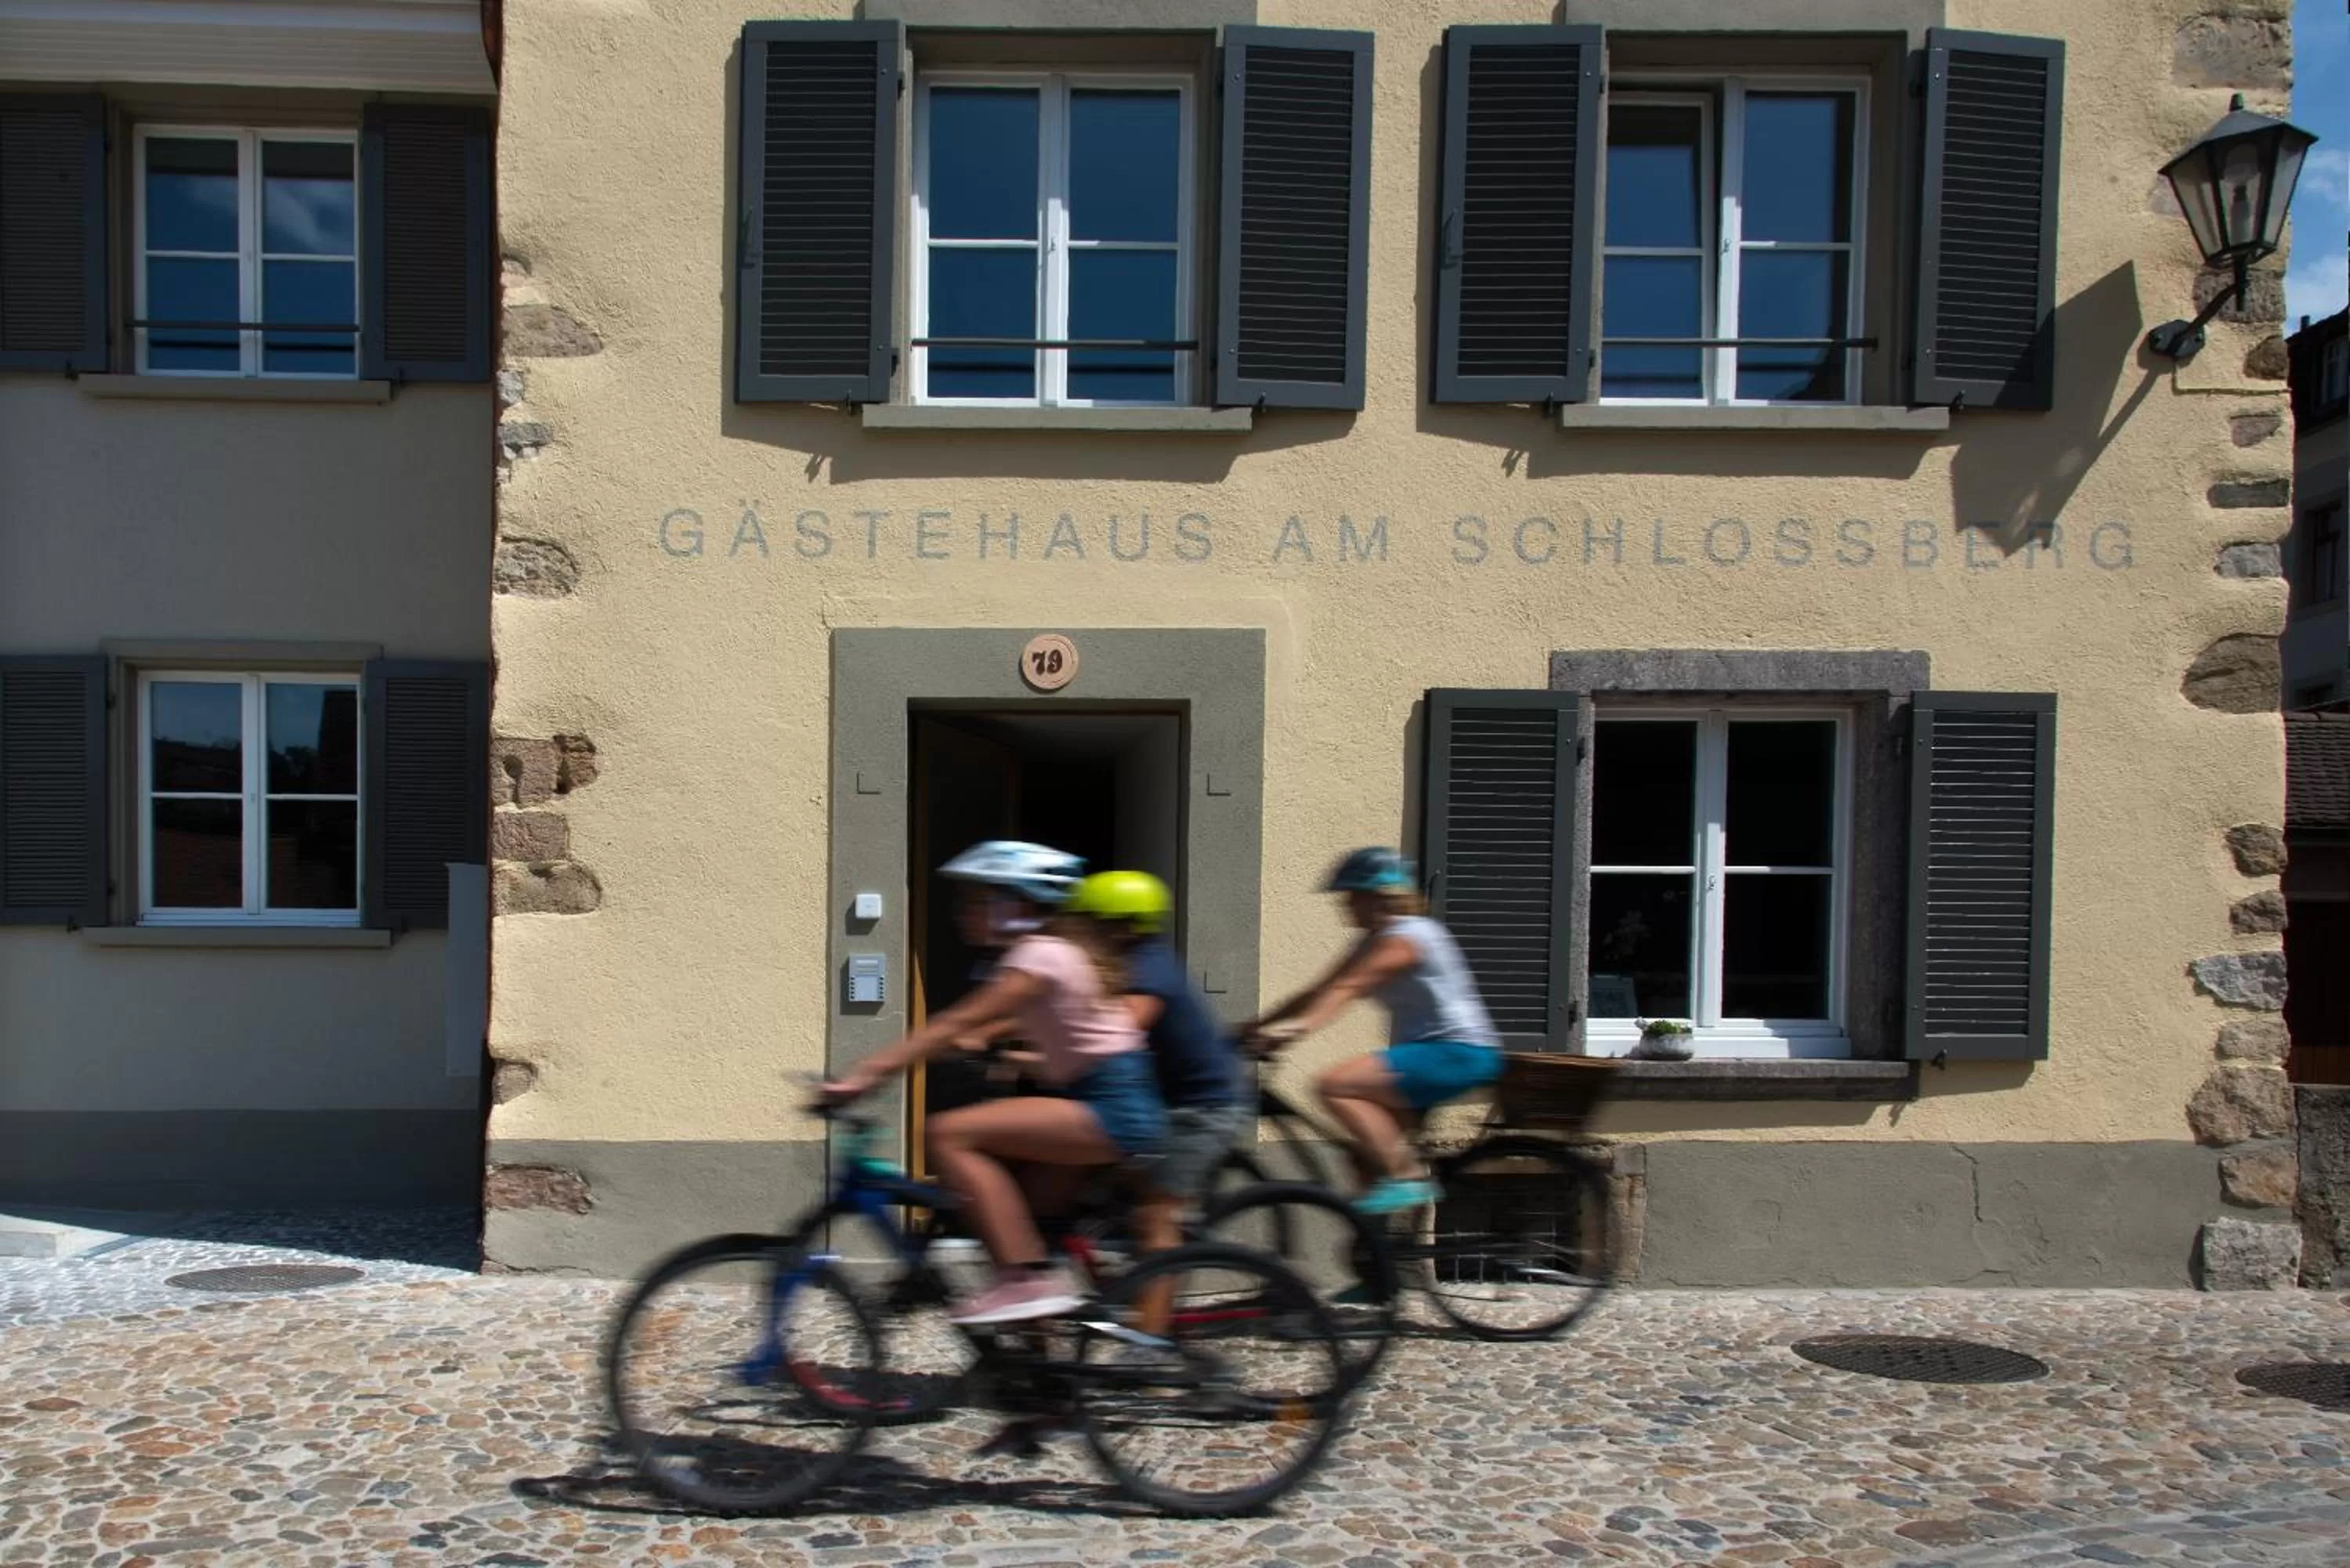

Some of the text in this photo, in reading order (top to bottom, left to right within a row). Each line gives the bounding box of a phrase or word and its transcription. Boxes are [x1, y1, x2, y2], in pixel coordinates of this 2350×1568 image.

[659, 500, 2135, 569] GÄSTEHAUS AM SCHLOSSBERG
[1032, 649, 1063, 676] 79
